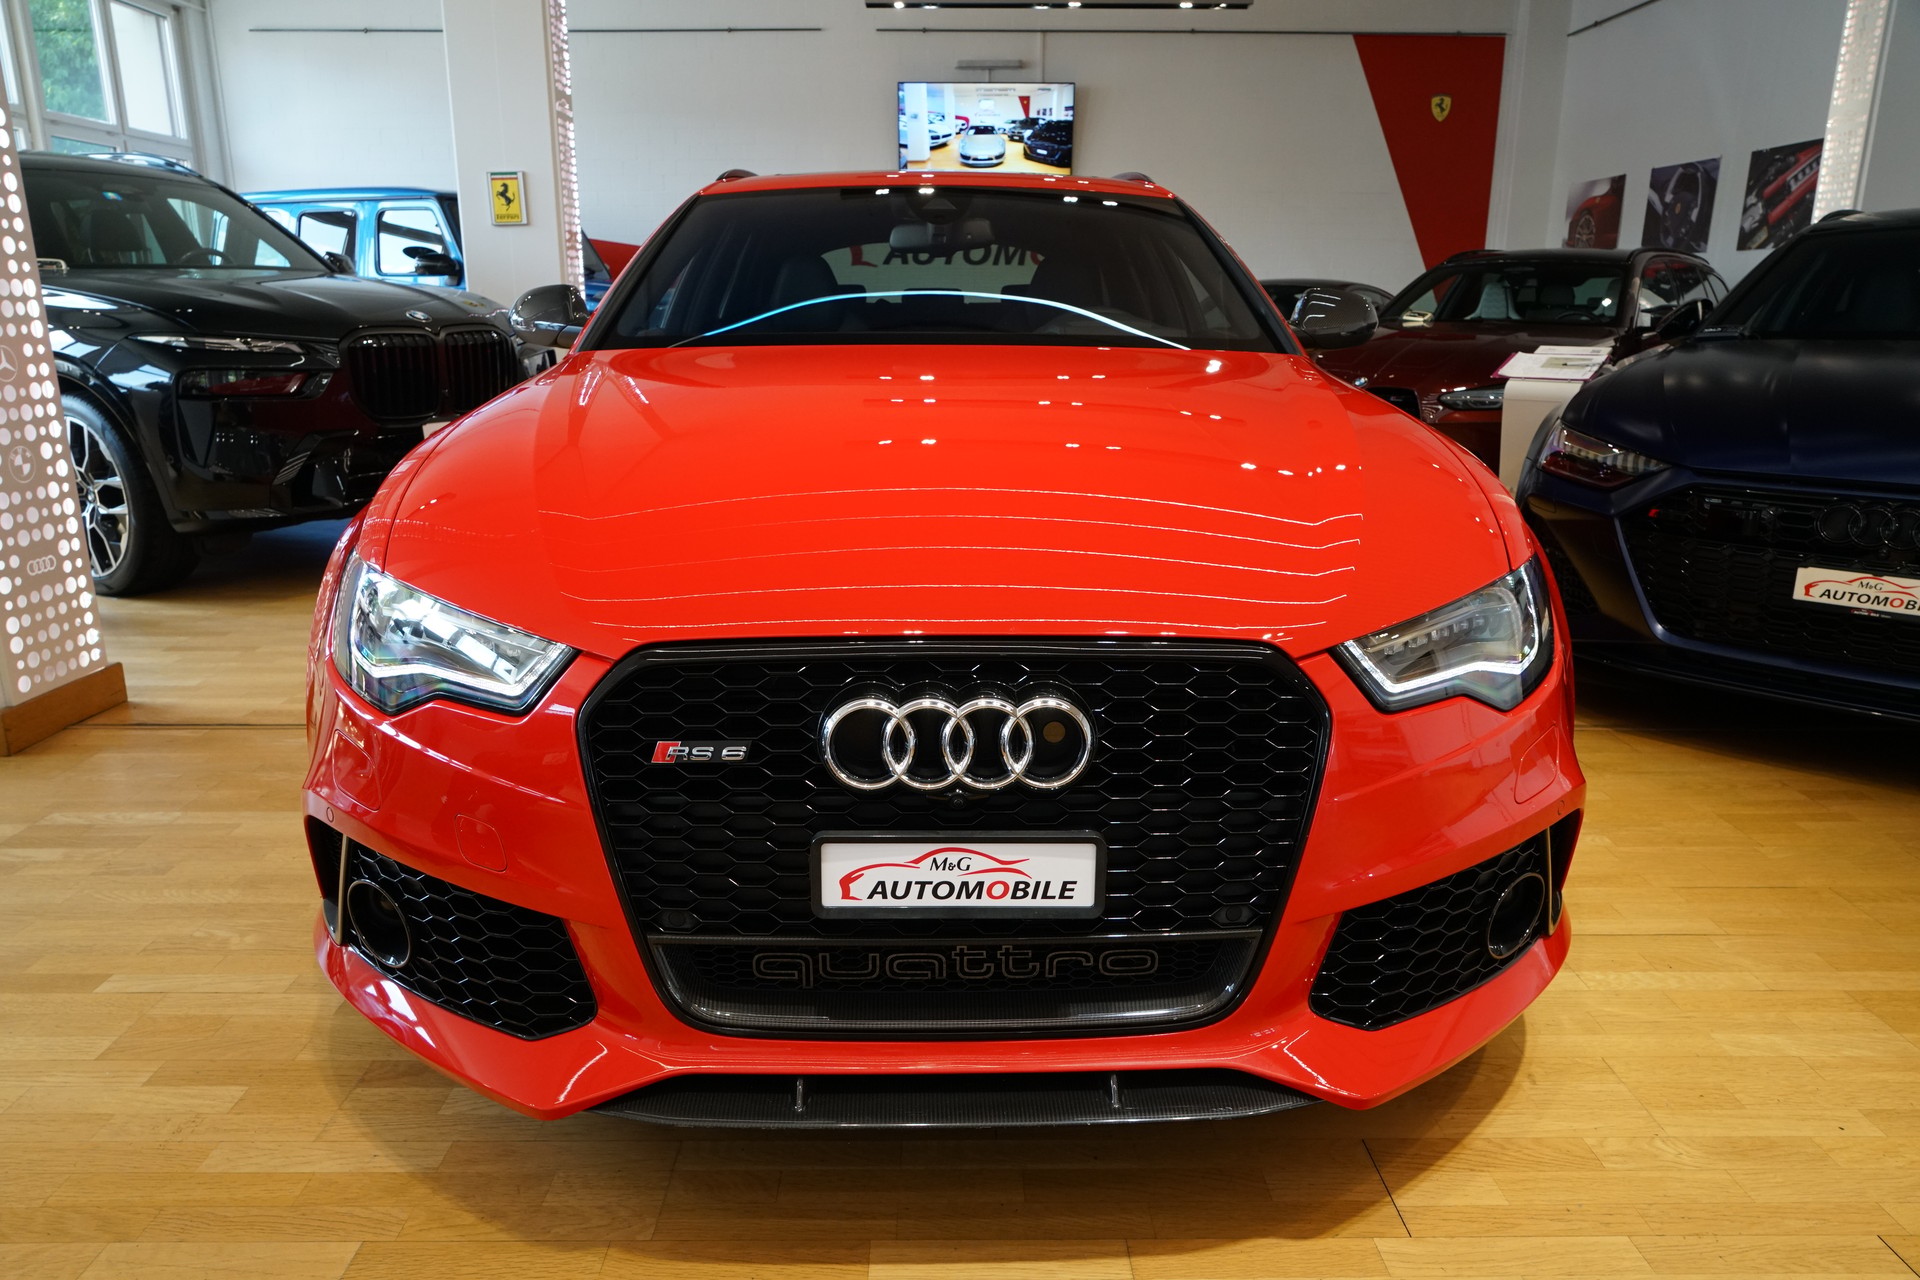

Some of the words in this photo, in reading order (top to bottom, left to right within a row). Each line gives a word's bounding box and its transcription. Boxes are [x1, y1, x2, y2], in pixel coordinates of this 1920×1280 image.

[1857, 580, 1884, 592] M&G
[1819, 588, 1920, 612] AUTOMOB
[664, 746, 715, 761] RS
[721, 746, 747, 761] 6
[929, 856, 972, 872] M&G
[866, 880, 1078, 901] AUTOMOBILE
[752, 945, 1159, 989] quattro
